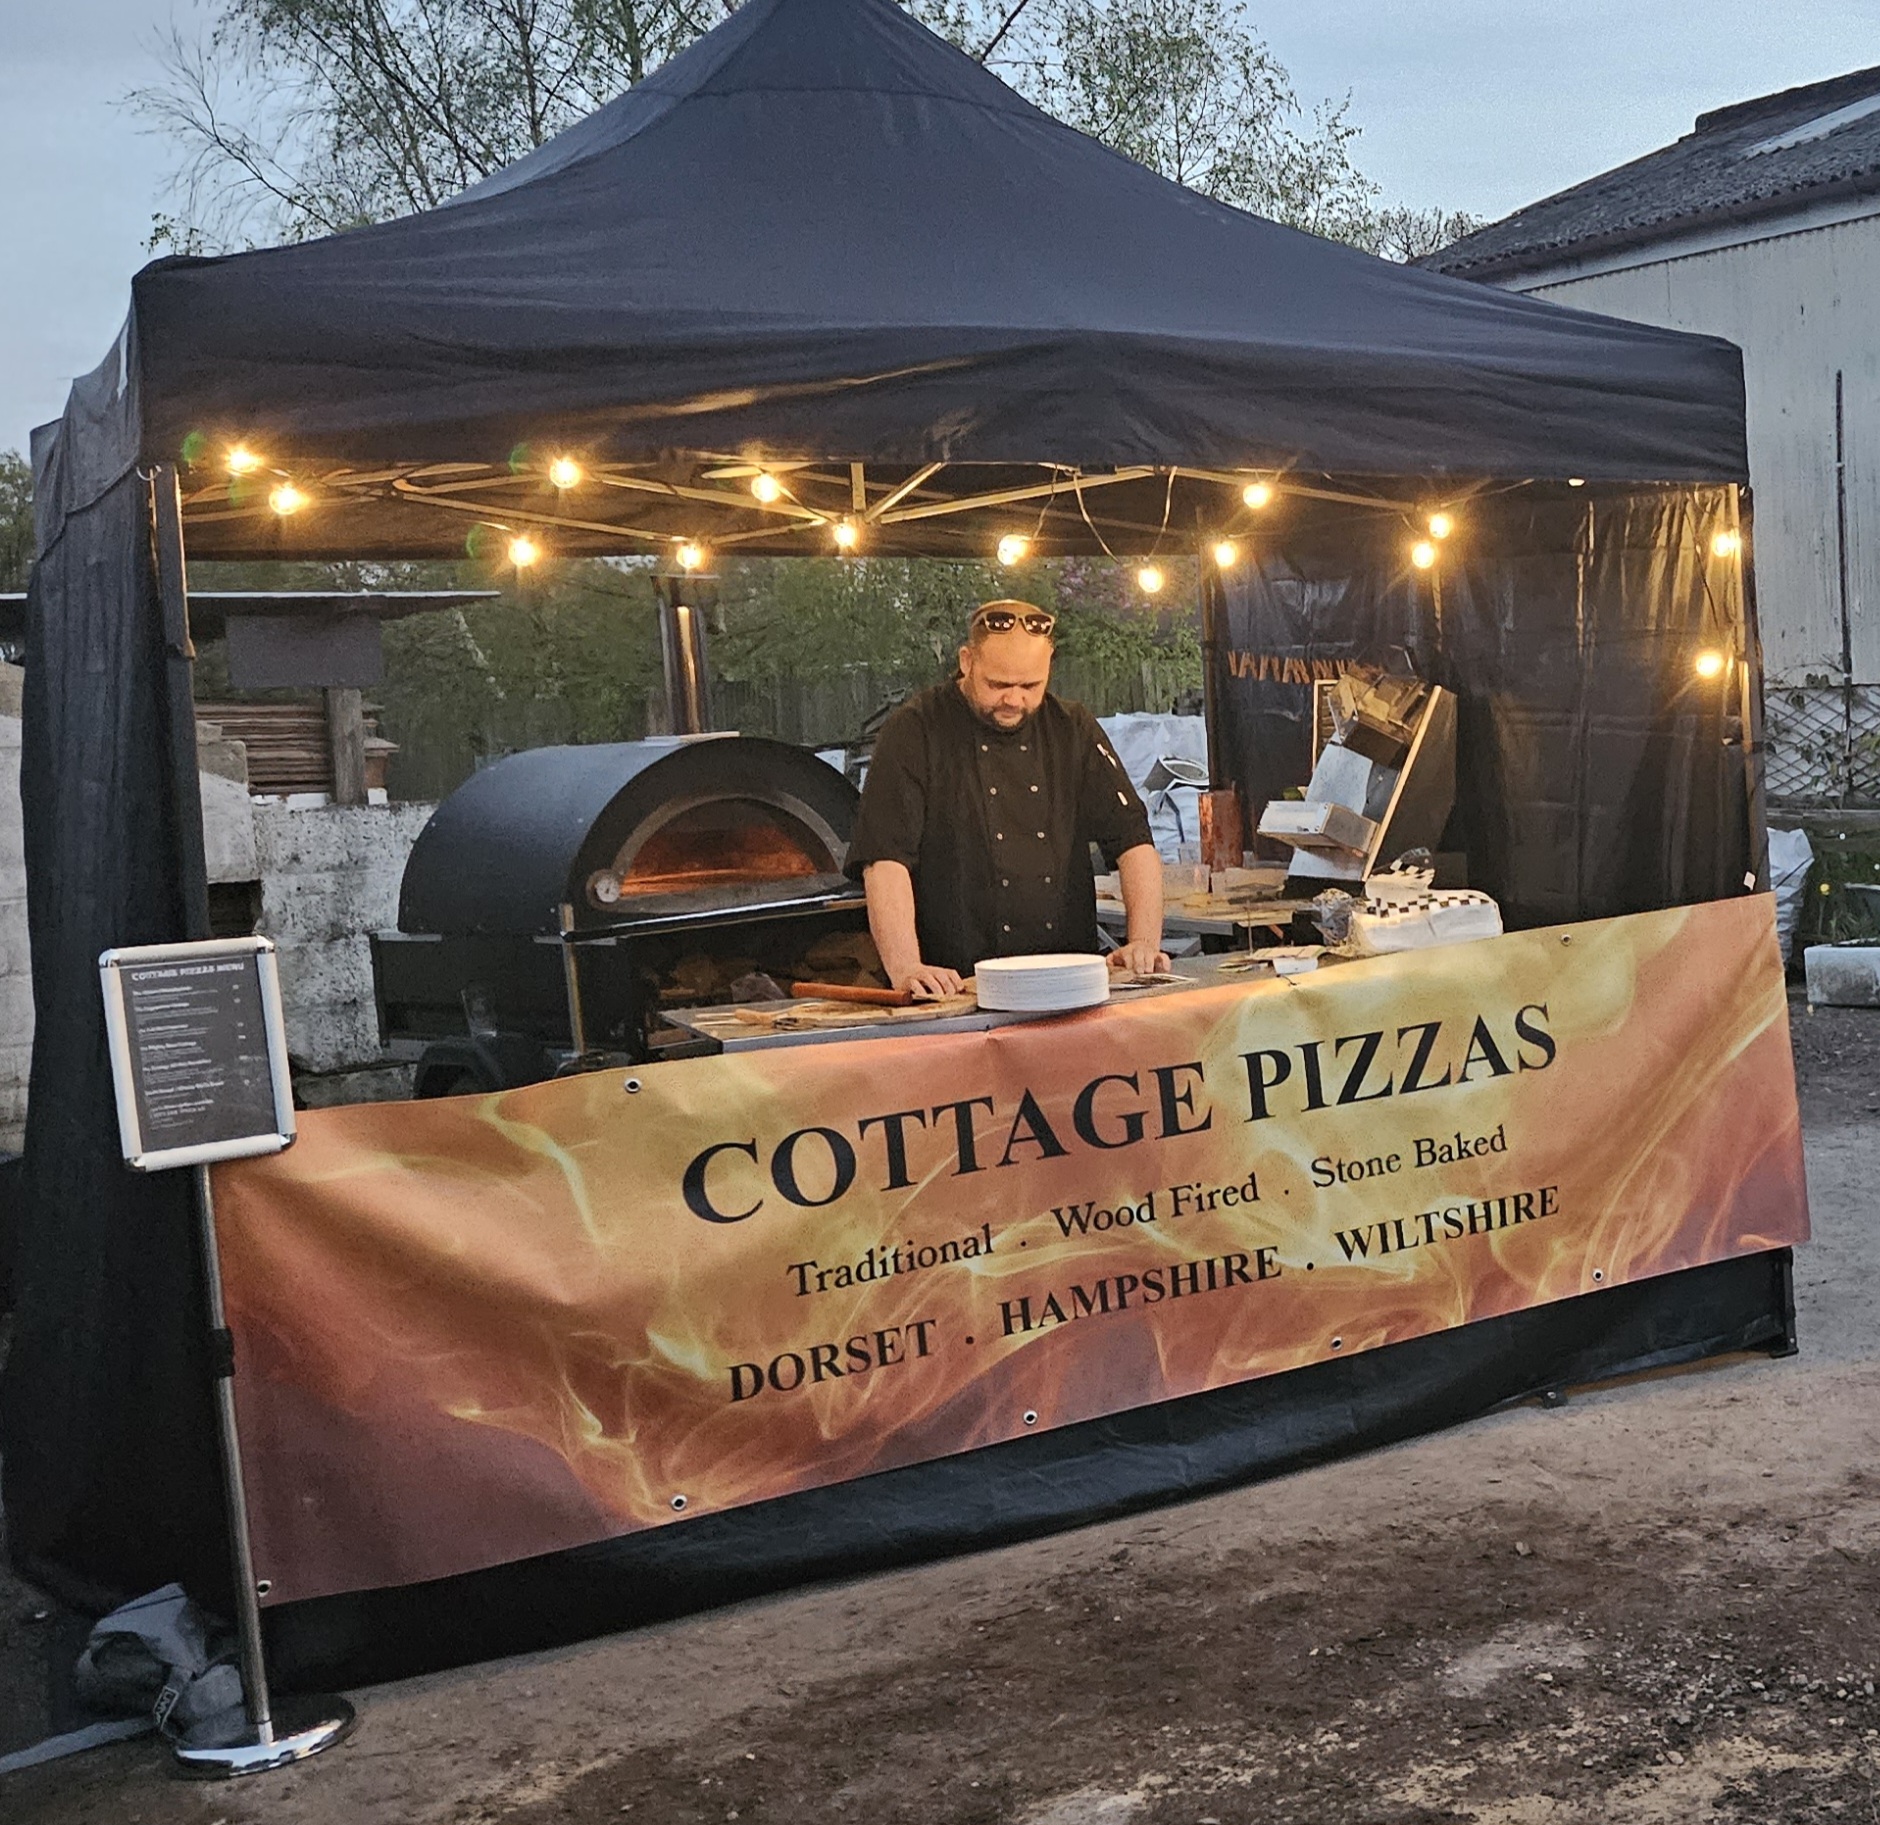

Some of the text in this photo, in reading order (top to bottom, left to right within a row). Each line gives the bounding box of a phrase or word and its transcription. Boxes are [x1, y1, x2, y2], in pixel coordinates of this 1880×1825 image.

[682, 1003, 1558, 1225] COTTAGE PIZZAS
[787, 1123, 1508, 1299] Traditional Wood Fired Stone Baked
[728, 1184, 1561, 1405] DORSET HAMPSHIRE WILTSHIRE
